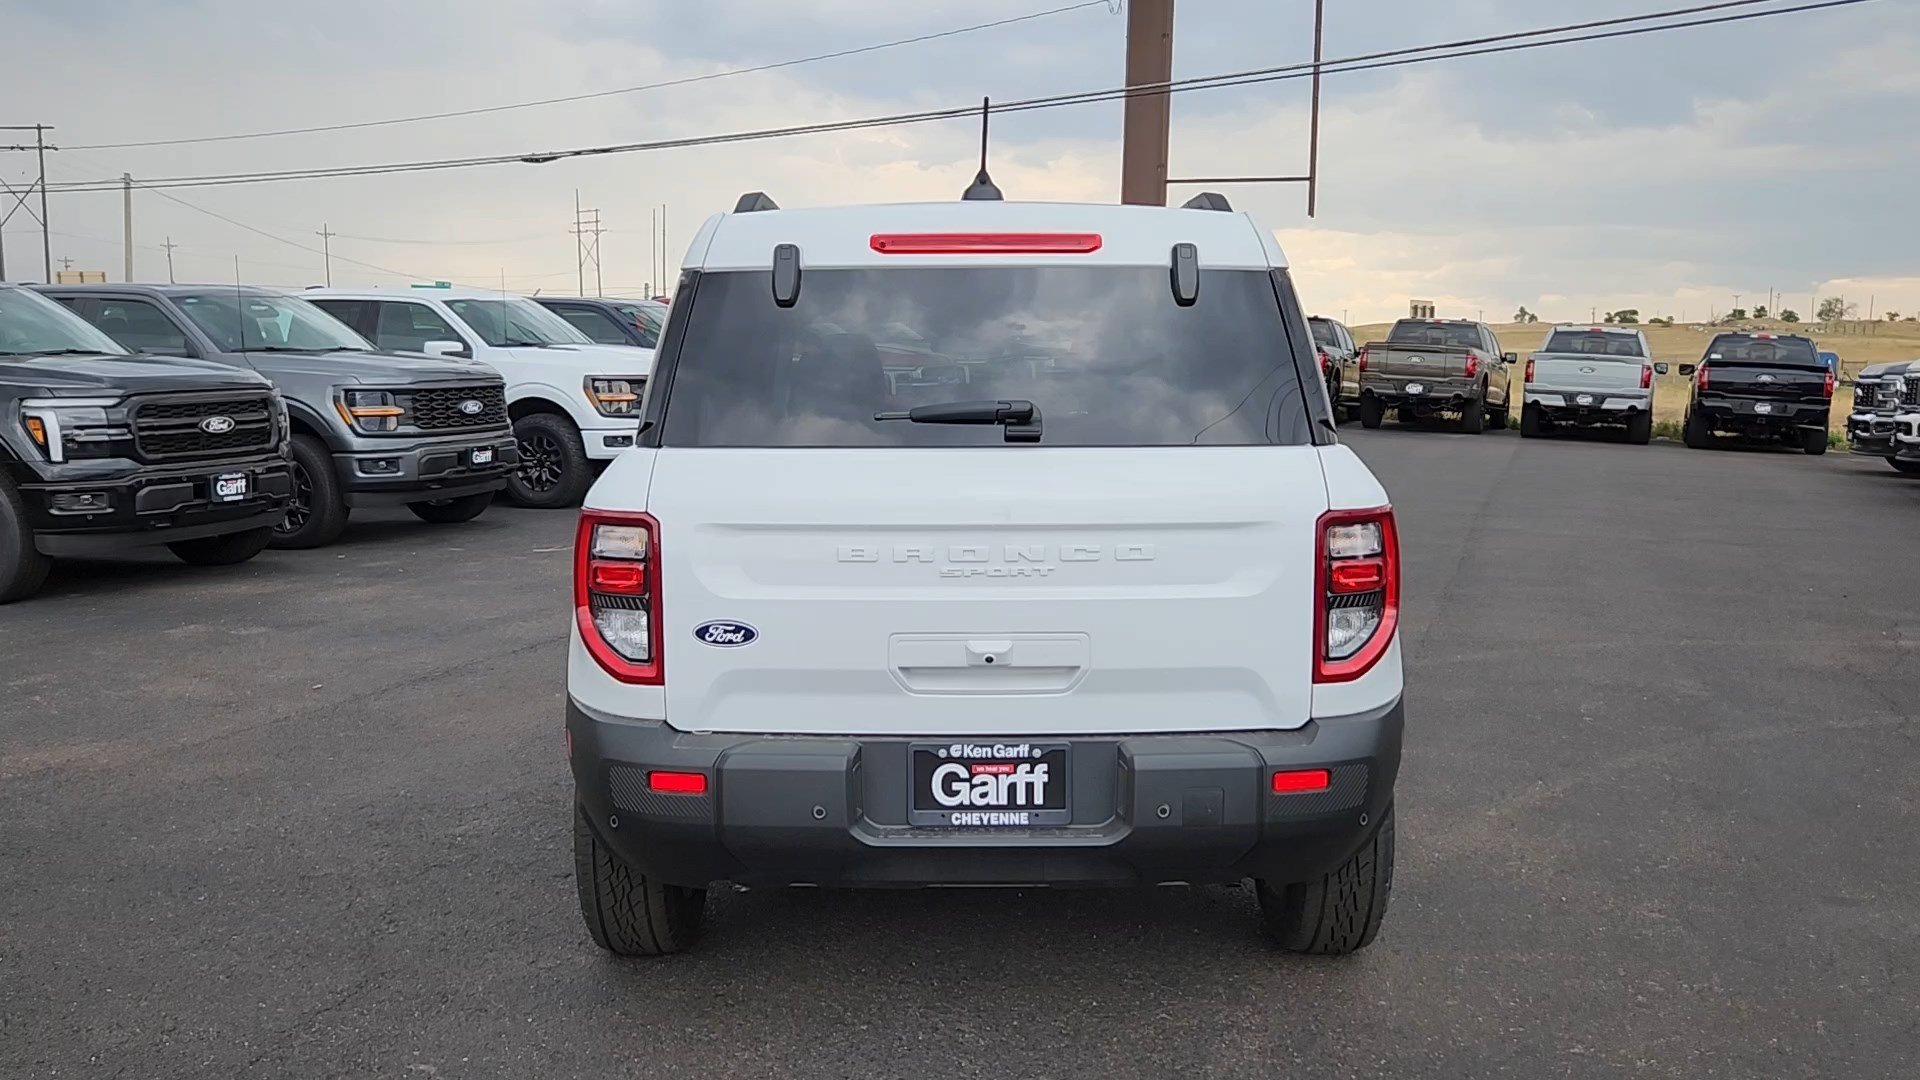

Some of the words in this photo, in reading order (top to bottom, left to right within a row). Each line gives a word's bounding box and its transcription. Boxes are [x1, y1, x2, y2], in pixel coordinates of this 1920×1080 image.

[208, 417, 229, 430] Ford
[216, 478, 247, 496] Garff
[837, 543, 1156, 562] BRONCO
[939, 566, 1056, 577] SPORT
[705, 625, 745, 642] Ford
[963, 744, 992, 758] Ken
[993, 744, 1030, 758] Garff
[931, 762, 1049, 807] Garff
[951, 812, 1029, 825] CHEYENNE
